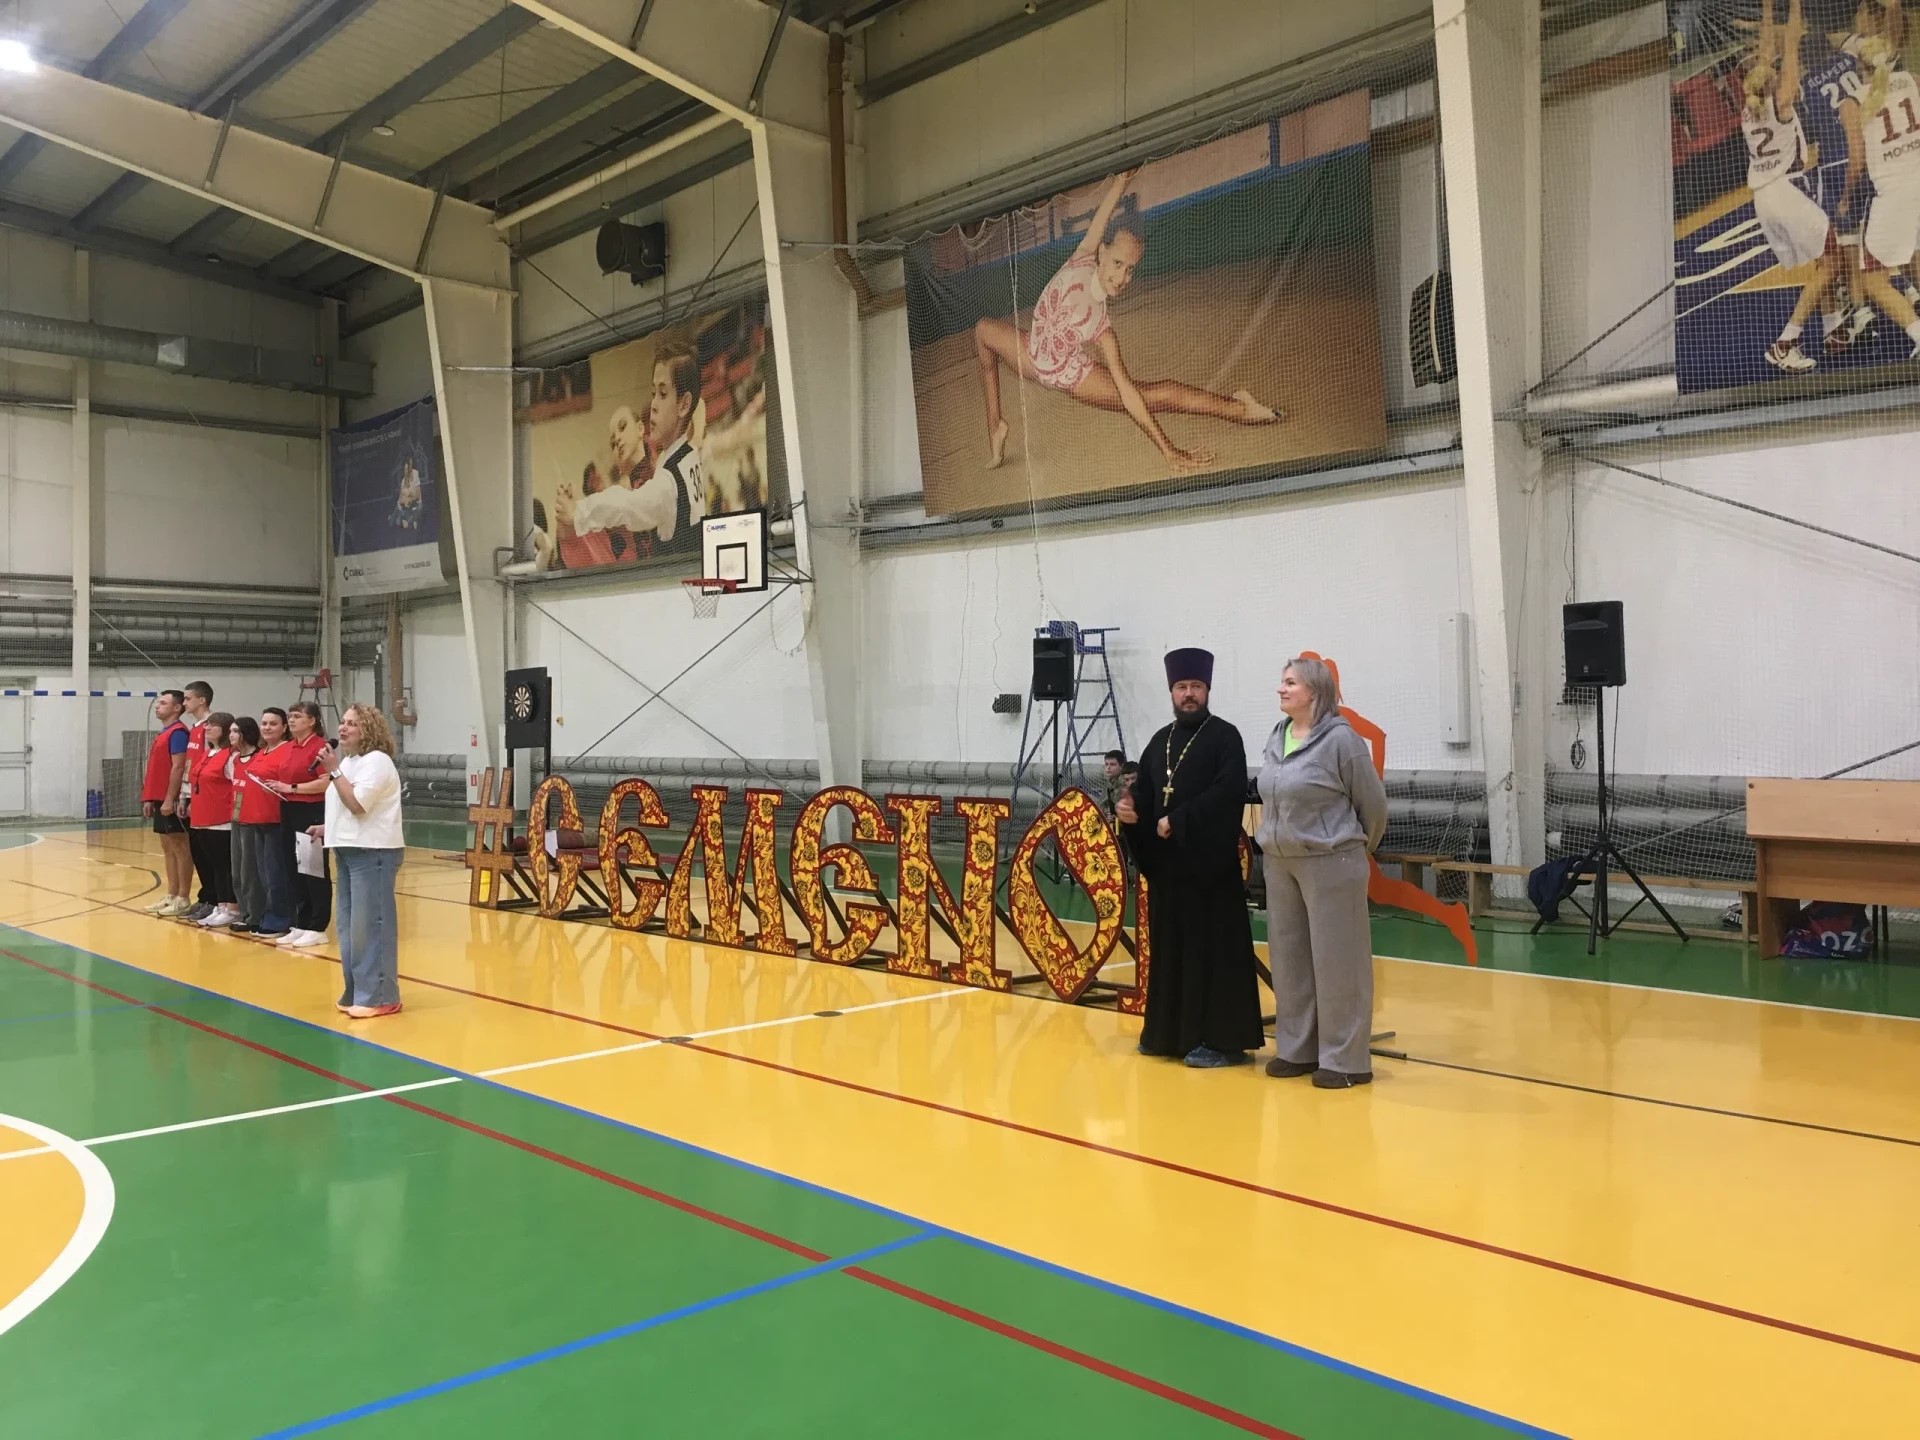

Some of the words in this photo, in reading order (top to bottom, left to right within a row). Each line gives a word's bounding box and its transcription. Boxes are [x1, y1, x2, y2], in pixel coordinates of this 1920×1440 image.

[1820, 71, 1861, 109] 20
[1876, 97, 1920, 144] 11
[1750, 127, 1780, 157] 2
